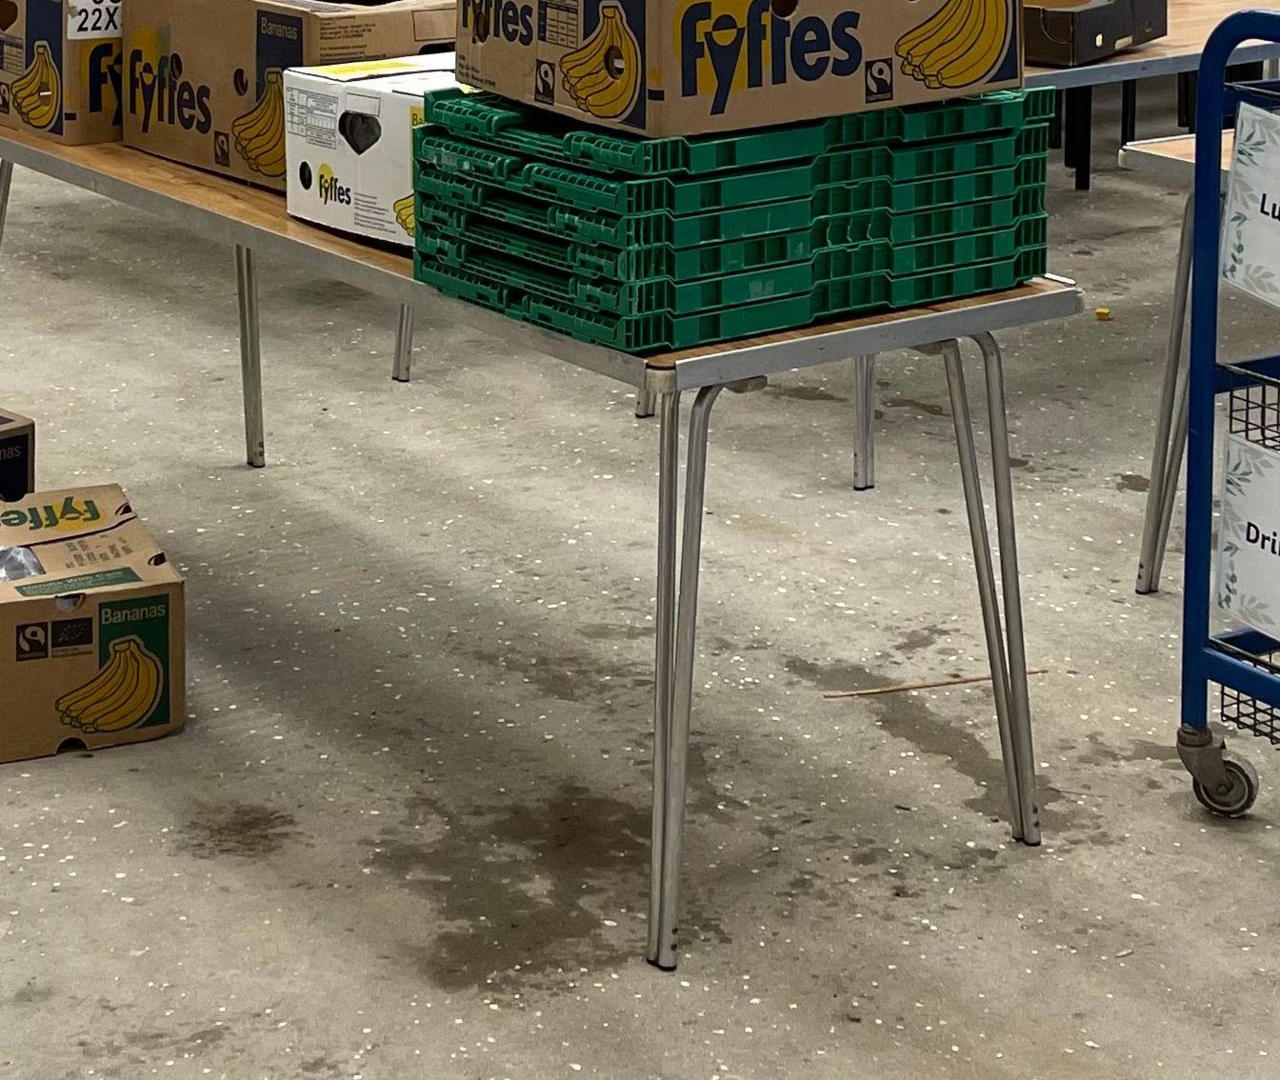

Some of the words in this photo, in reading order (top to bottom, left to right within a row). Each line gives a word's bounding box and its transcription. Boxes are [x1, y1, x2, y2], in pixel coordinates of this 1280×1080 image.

[77, 6, 122, 32] 22X
[261, 16, 298, 40] Bananas
[101, 604, 166, 624] Bananas
